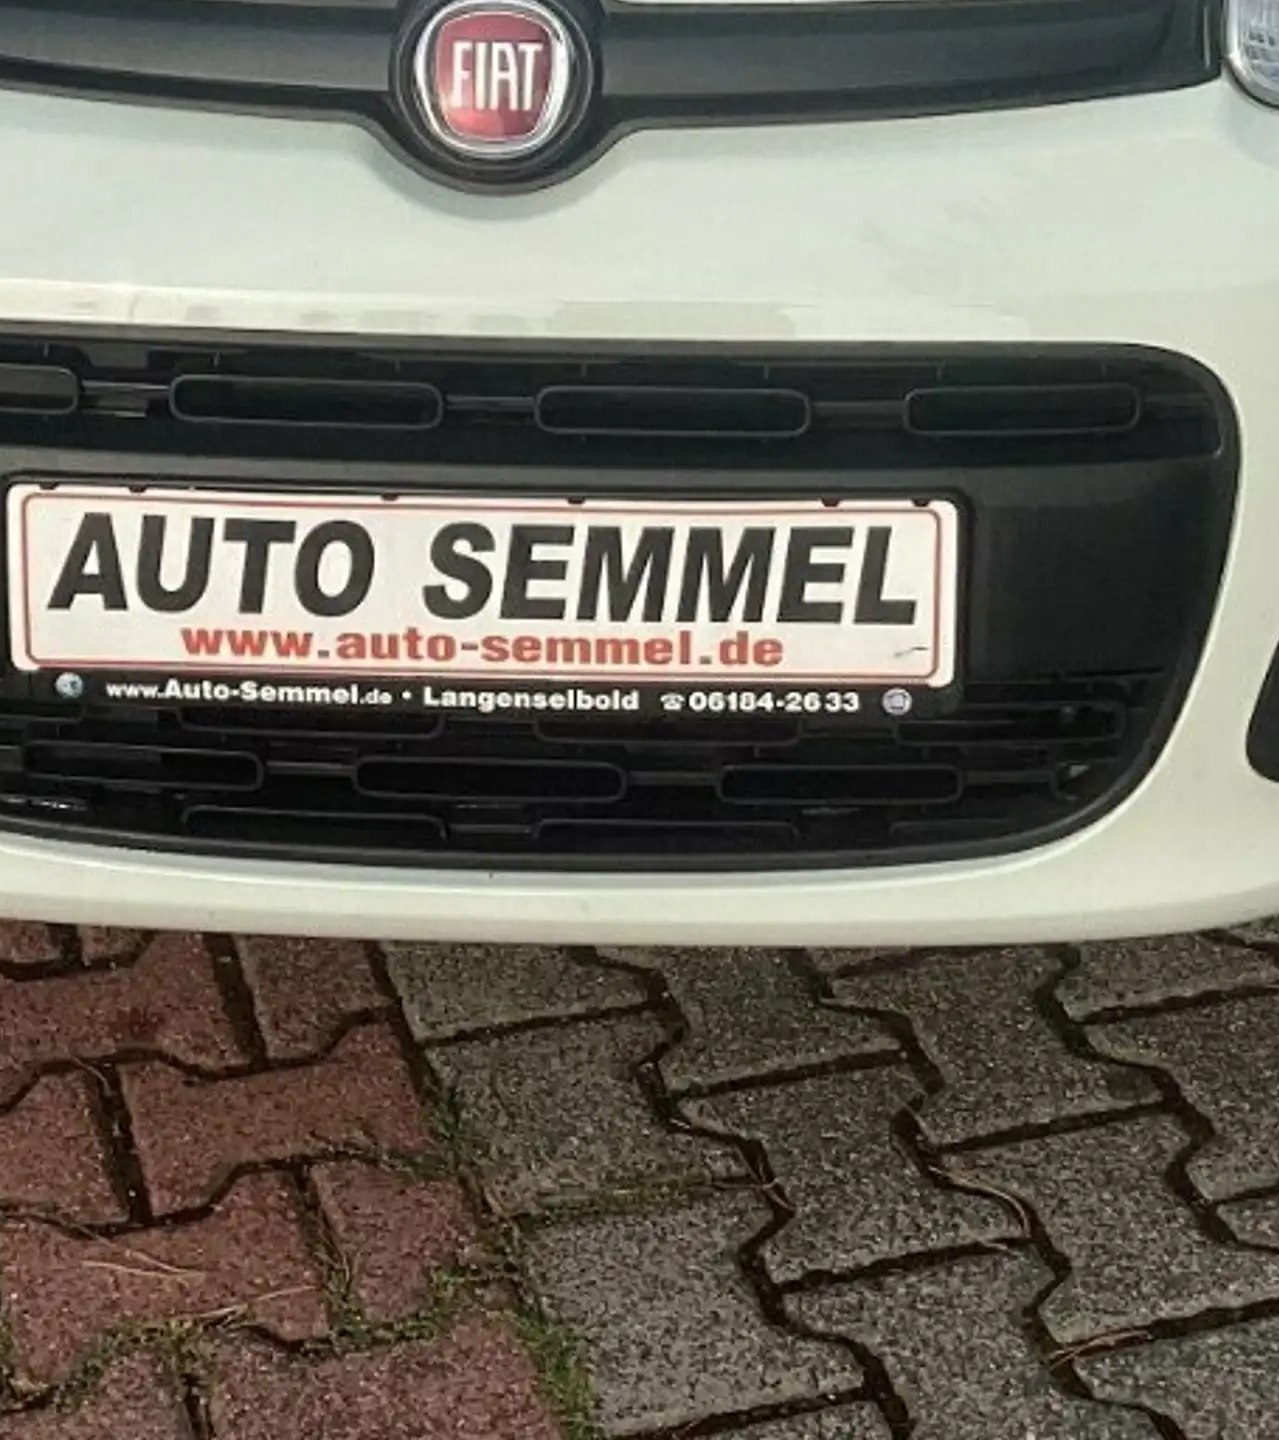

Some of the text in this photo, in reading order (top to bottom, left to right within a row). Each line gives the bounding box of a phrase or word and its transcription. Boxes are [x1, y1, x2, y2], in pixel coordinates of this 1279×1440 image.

[449, 41, 544, 112] FIAT
[47, 512, 918, 625] AUTO SEMMEL
[180, 627, 784, 666] www.auto-semmel.de
[105, 677, 392, 705] www.Auto-Semmel.de
[423, 685, 640, 713] Langenselbold
